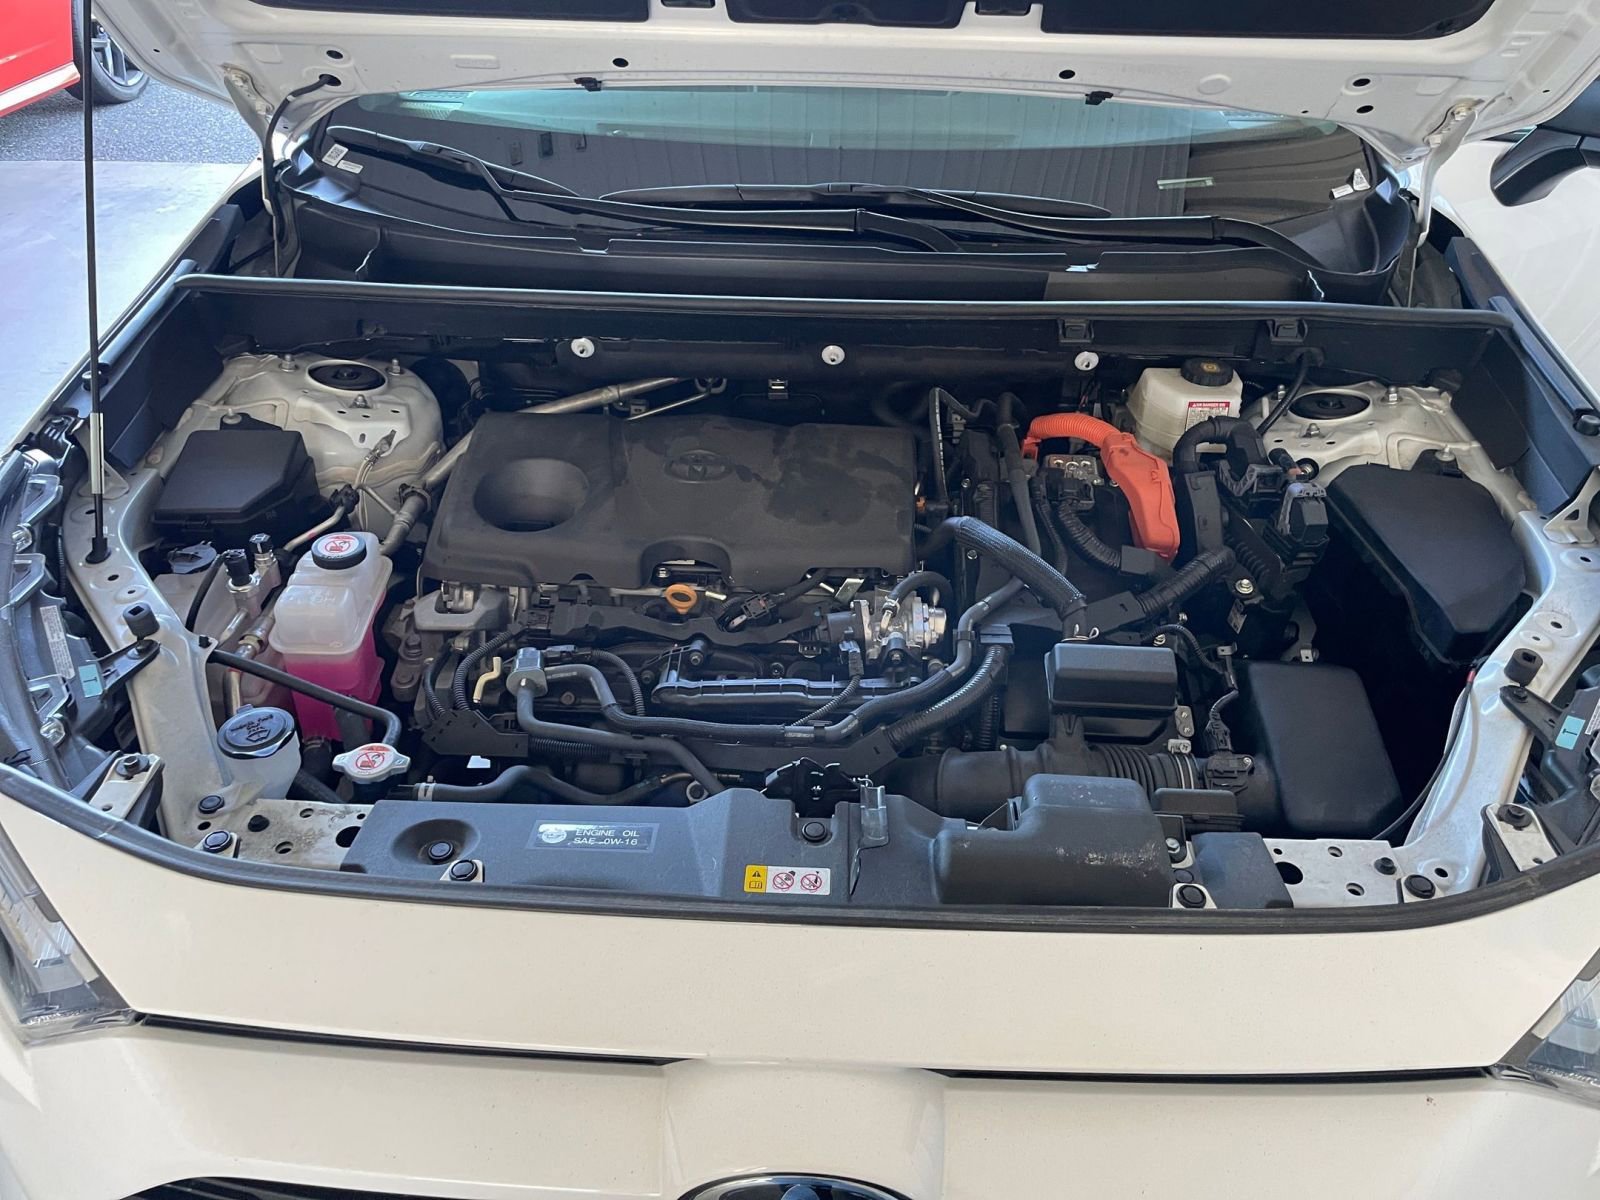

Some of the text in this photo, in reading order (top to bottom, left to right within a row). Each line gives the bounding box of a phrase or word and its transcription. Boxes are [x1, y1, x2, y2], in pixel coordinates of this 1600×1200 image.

[575, 829, 640, 837] ENGINE OIL
[573, 837, 596, 845] SAE
